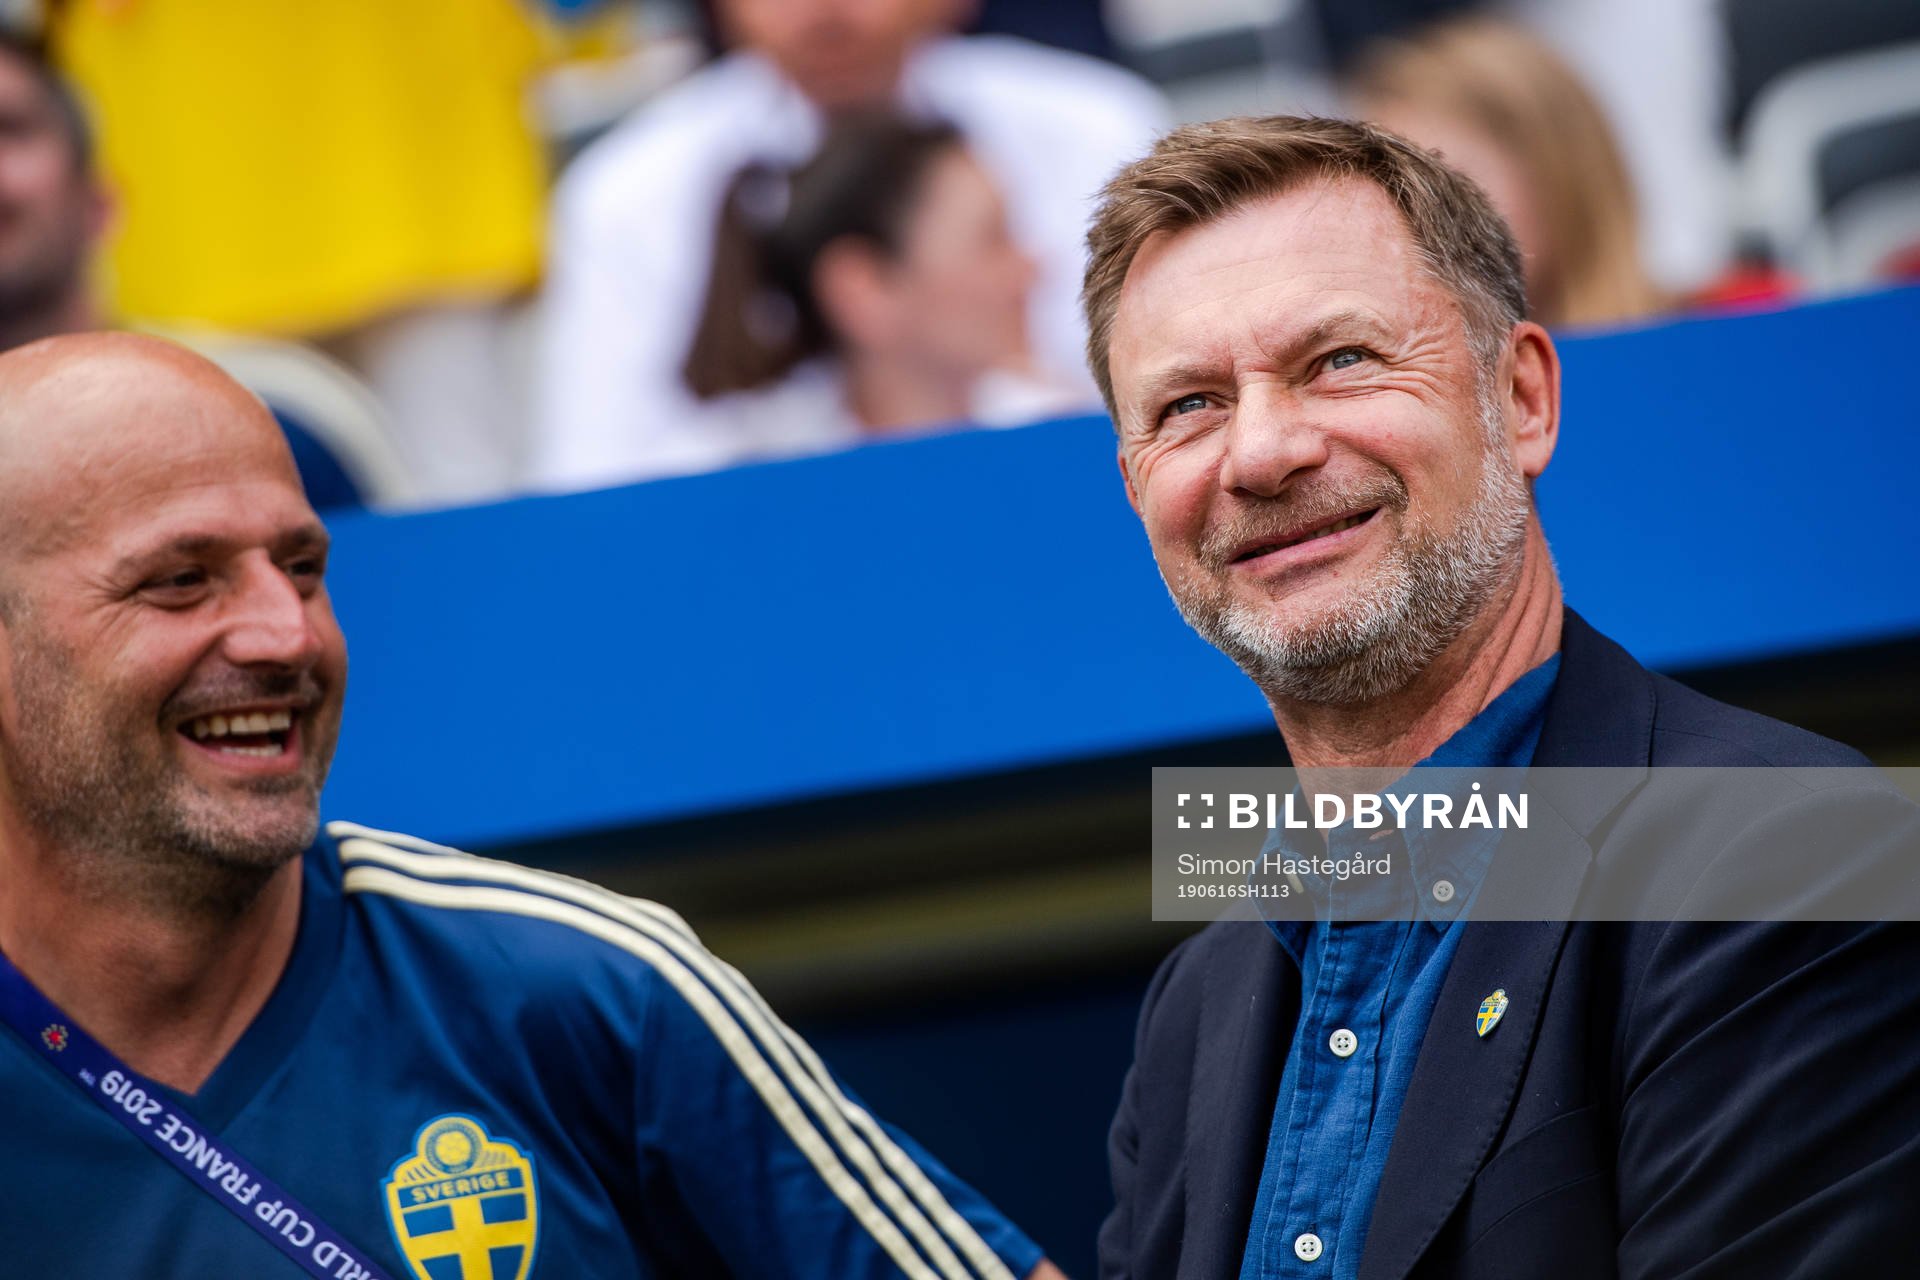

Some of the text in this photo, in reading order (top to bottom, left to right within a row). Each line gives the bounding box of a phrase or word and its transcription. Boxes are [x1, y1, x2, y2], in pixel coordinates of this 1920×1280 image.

[100, 1070, 162, 1126] 2019
[154, 1114, 262, 1206] FRANCE
[411, 1171, 510, 1203] SVERIGE
[255, 1200, 316, 1248] CUP
